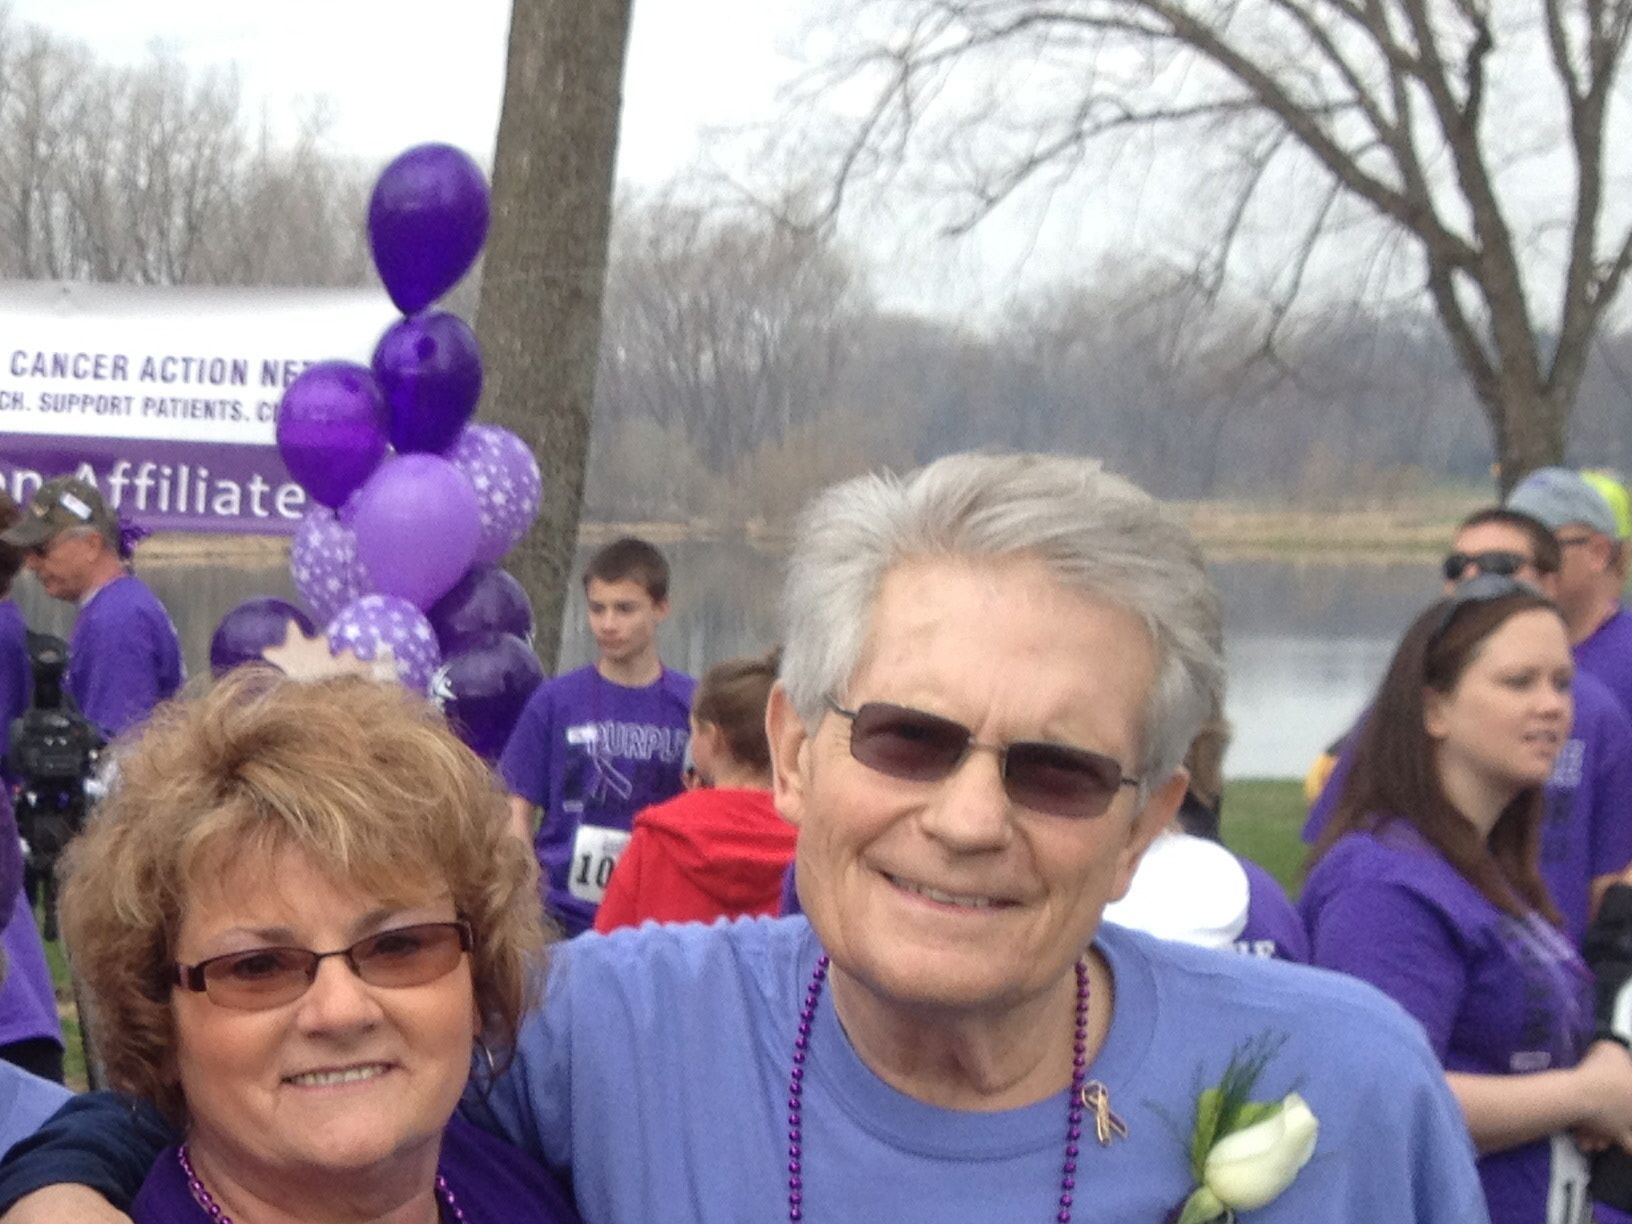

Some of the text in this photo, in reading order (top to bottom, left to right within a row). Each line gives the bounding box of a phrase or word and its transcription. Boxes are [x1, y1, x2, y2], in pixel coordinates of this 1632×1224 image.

[9, 349, 125, 381] CANCER
[139, 355, 249, 388] ACTION
[38, 391, 133, 417] SUPPORT
[141, 396, 249, 422] PATIENTS.
